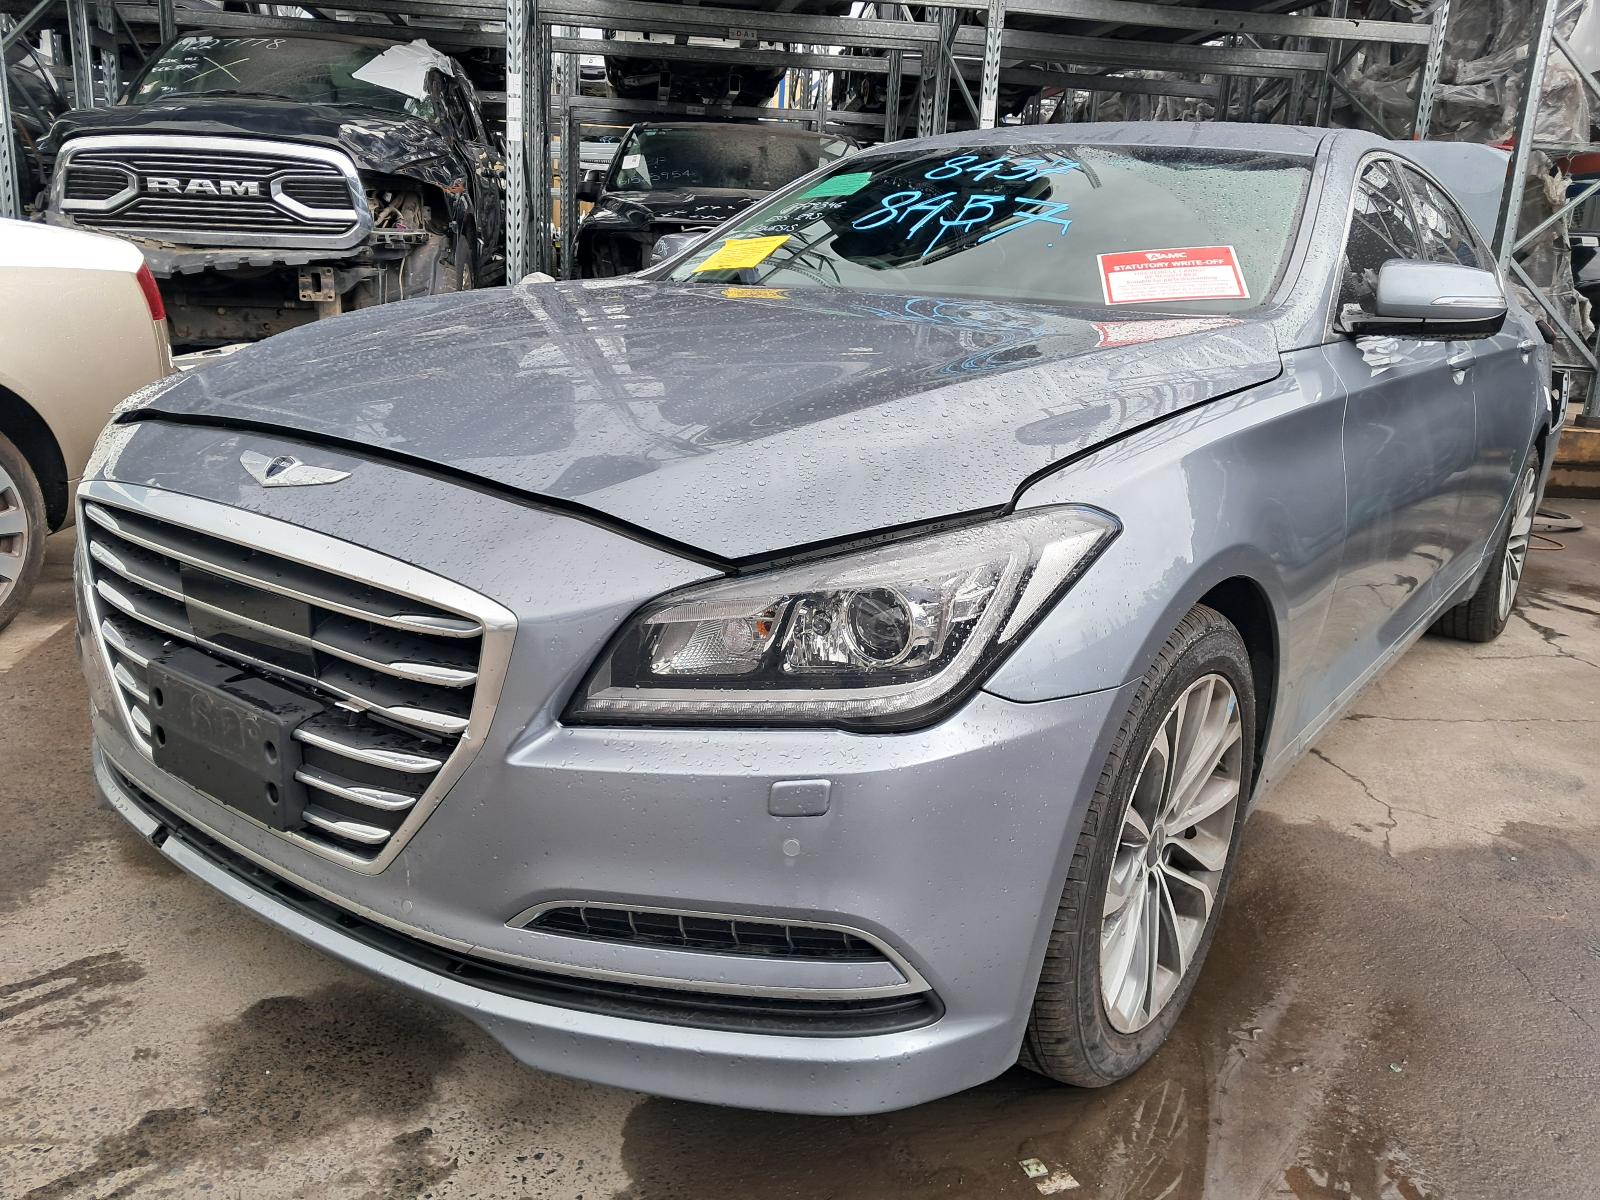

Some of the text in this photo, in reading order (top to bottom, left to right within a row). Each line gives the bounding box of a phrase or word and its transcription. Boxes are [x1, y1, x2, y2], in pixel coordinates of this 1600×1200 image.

[146, 177, 260, 196] RAM
[1113, 258, 1225, 271] STATUTORY WRITE-OFF
